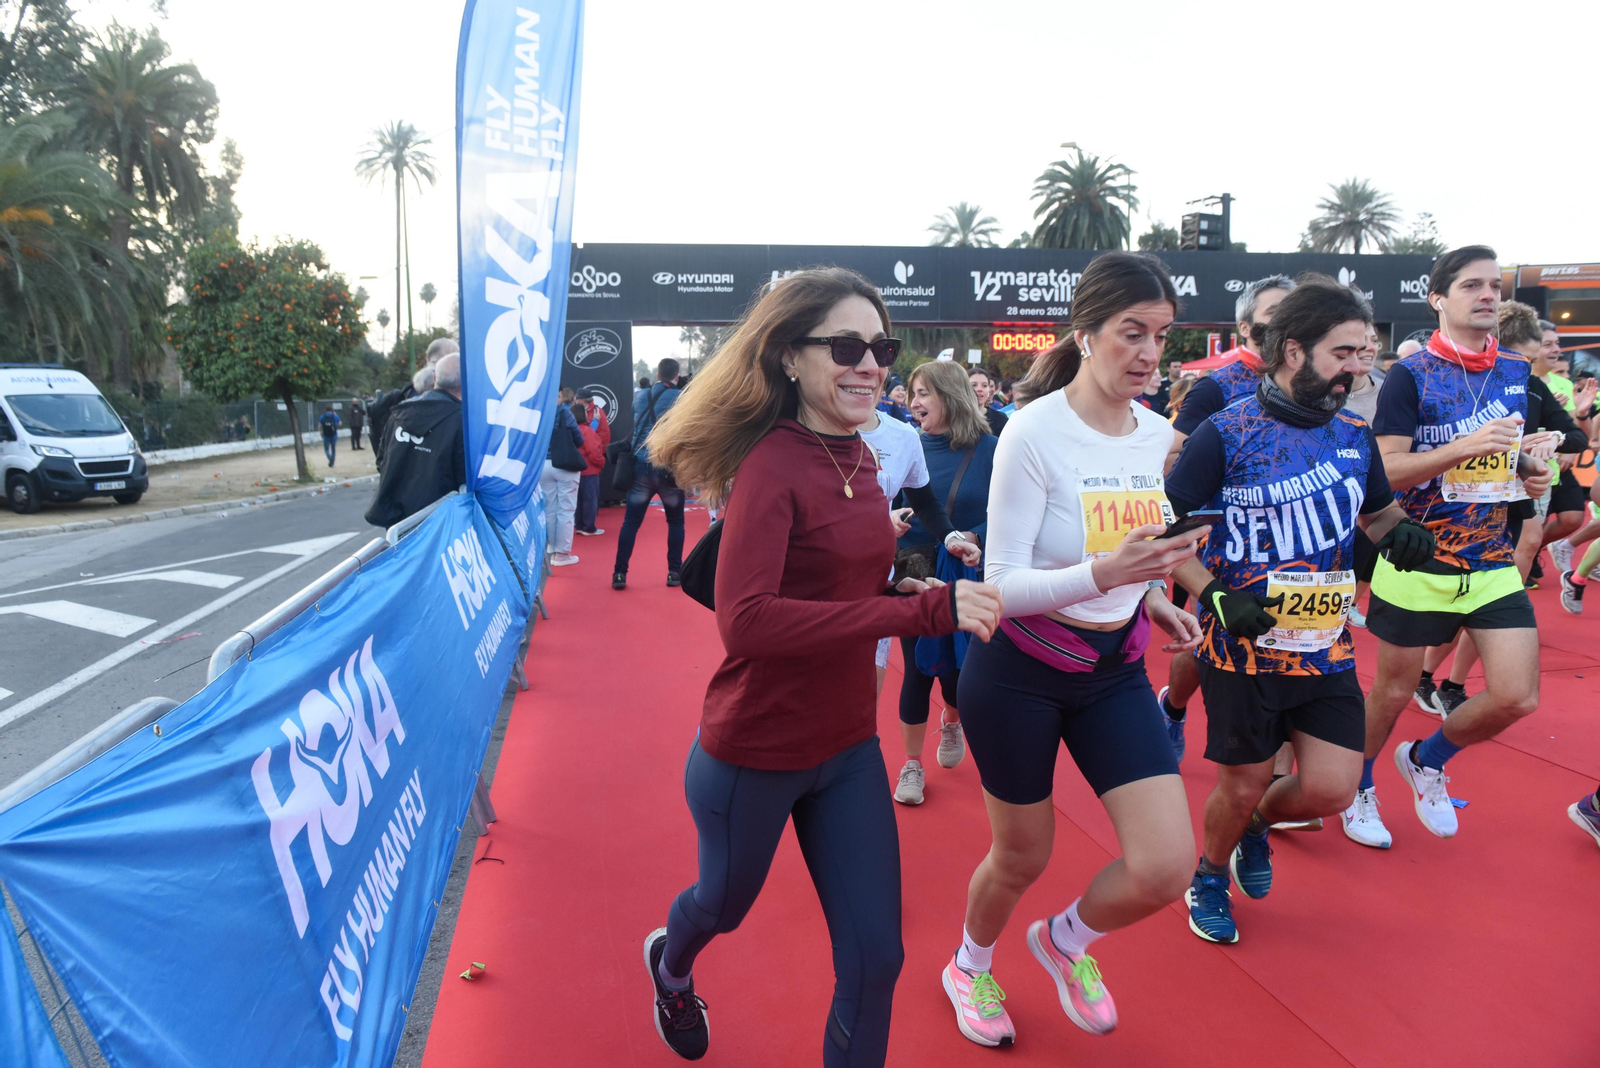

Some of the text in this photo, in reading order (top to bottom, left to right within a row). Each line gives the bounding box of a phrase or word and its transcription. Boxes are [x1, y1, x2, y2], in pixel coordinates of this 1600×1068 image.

[513, 6, 540, 157] HUMAN
[485, 84, 511, 151] FLY
[541, 91, 565, 162] FLY
[678, 273, 734, 284] HYUNDAI
[995, 268, 1083, 287] maratón
[1169, 275, 1199, 297] KA
[478, 170, 563, 486] HOKA
[1006, 306, 1069, 316] 28 enero 2024
[993, 333, 1055, 351] 00:06:02
[1413, 398, 1510, 444] MEDIO MARATÓN
[1336, 448, 1362, 460] HOKA
[1455, 452, 1508, 471] 2451
[1222, 460, 1342, 507] MEDIO MARATÓN
[1092, 498, 1162, 533] 11400
[1225, 475, 1365, 564] SEVILLA
[440, 525, 497, 632] HOKA
[1276, 591, 1342, 617] 12459
[251, 634, 406, 939] HOKA
[319, 765, 427, 1042] FLY HUMAN FLY
